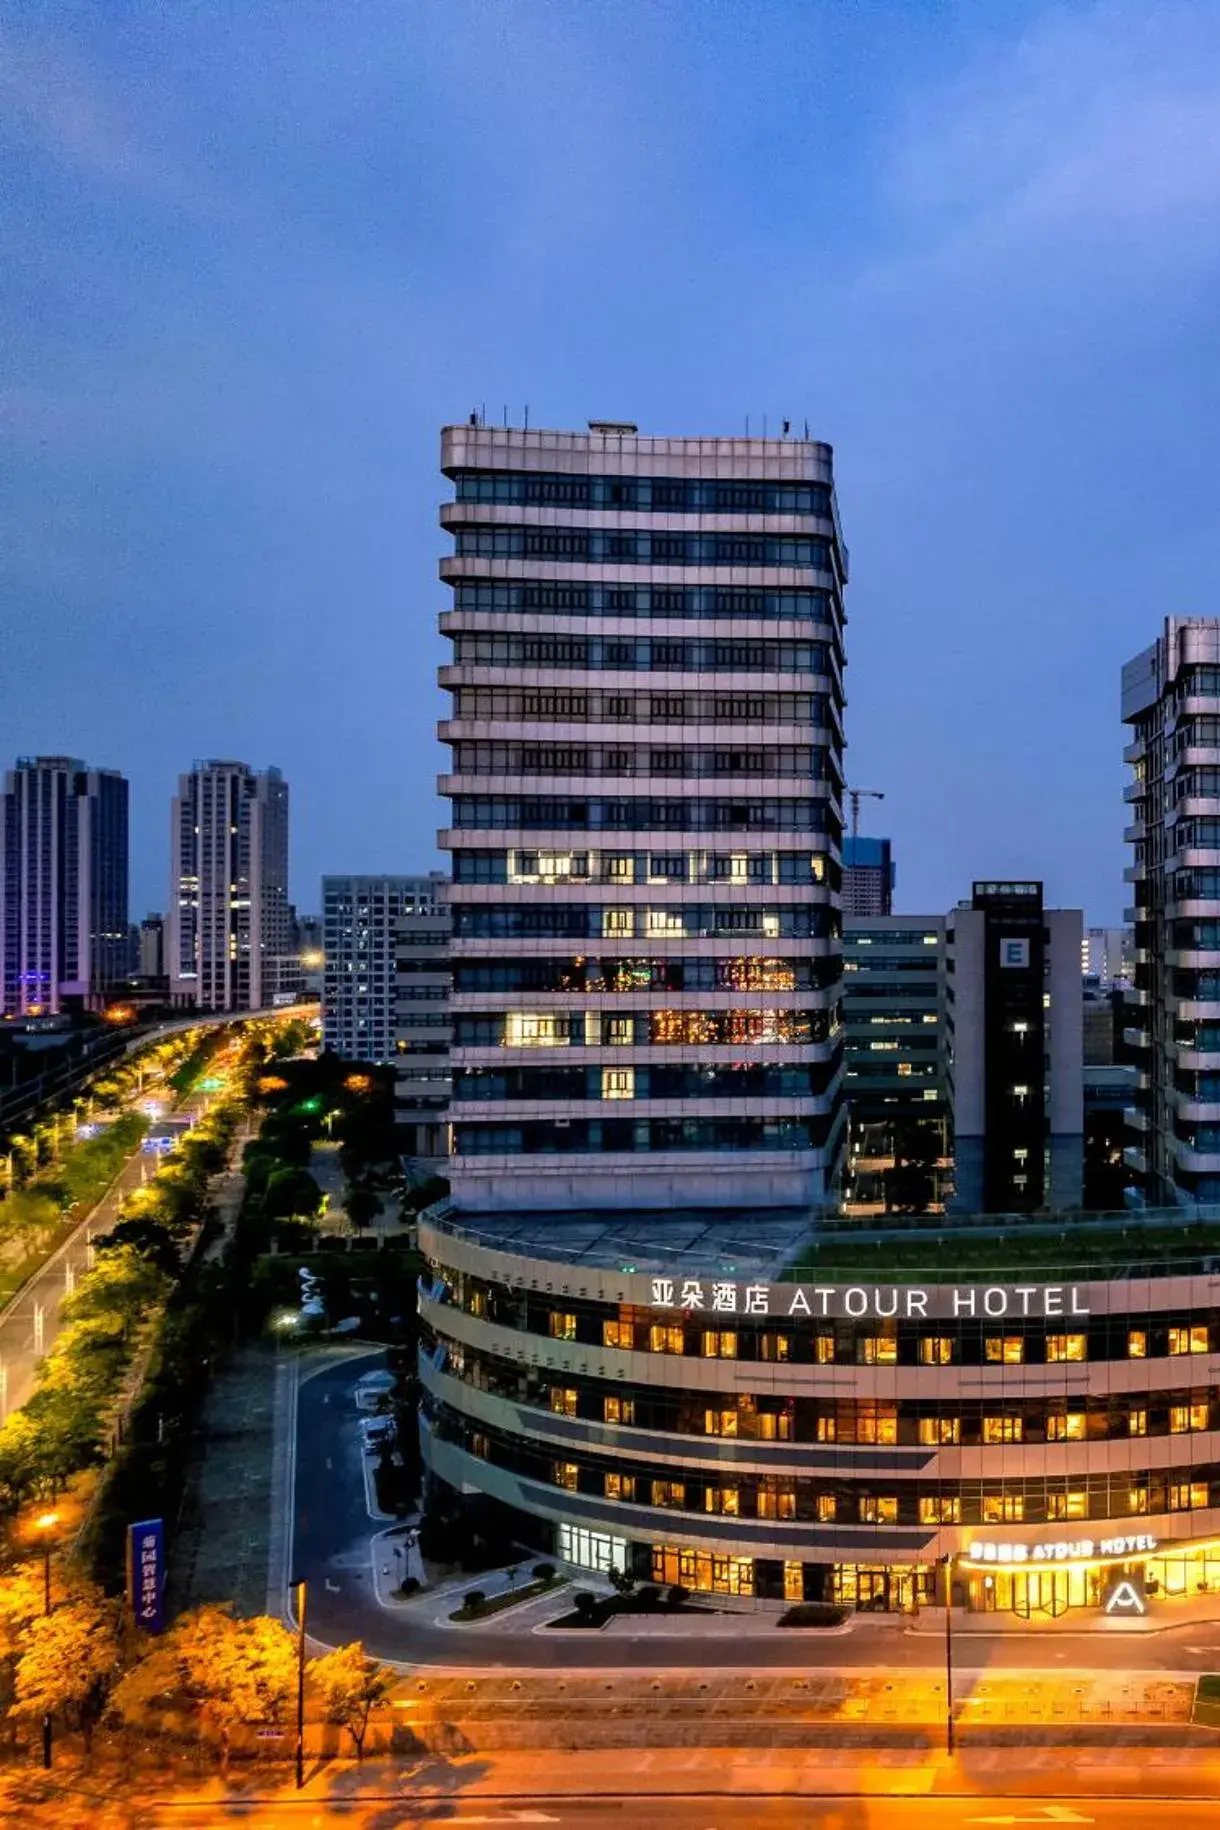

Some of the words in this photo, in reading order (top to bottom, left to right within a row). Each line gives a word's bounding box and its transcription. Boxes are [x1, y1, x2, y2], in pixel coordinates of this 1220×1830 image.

[651, 1279, 770, 1314] 亚朵酒店
[788, 1287, 929, 1318] ATOUR
[953, 1287, 1091, 1316] HOTEL
